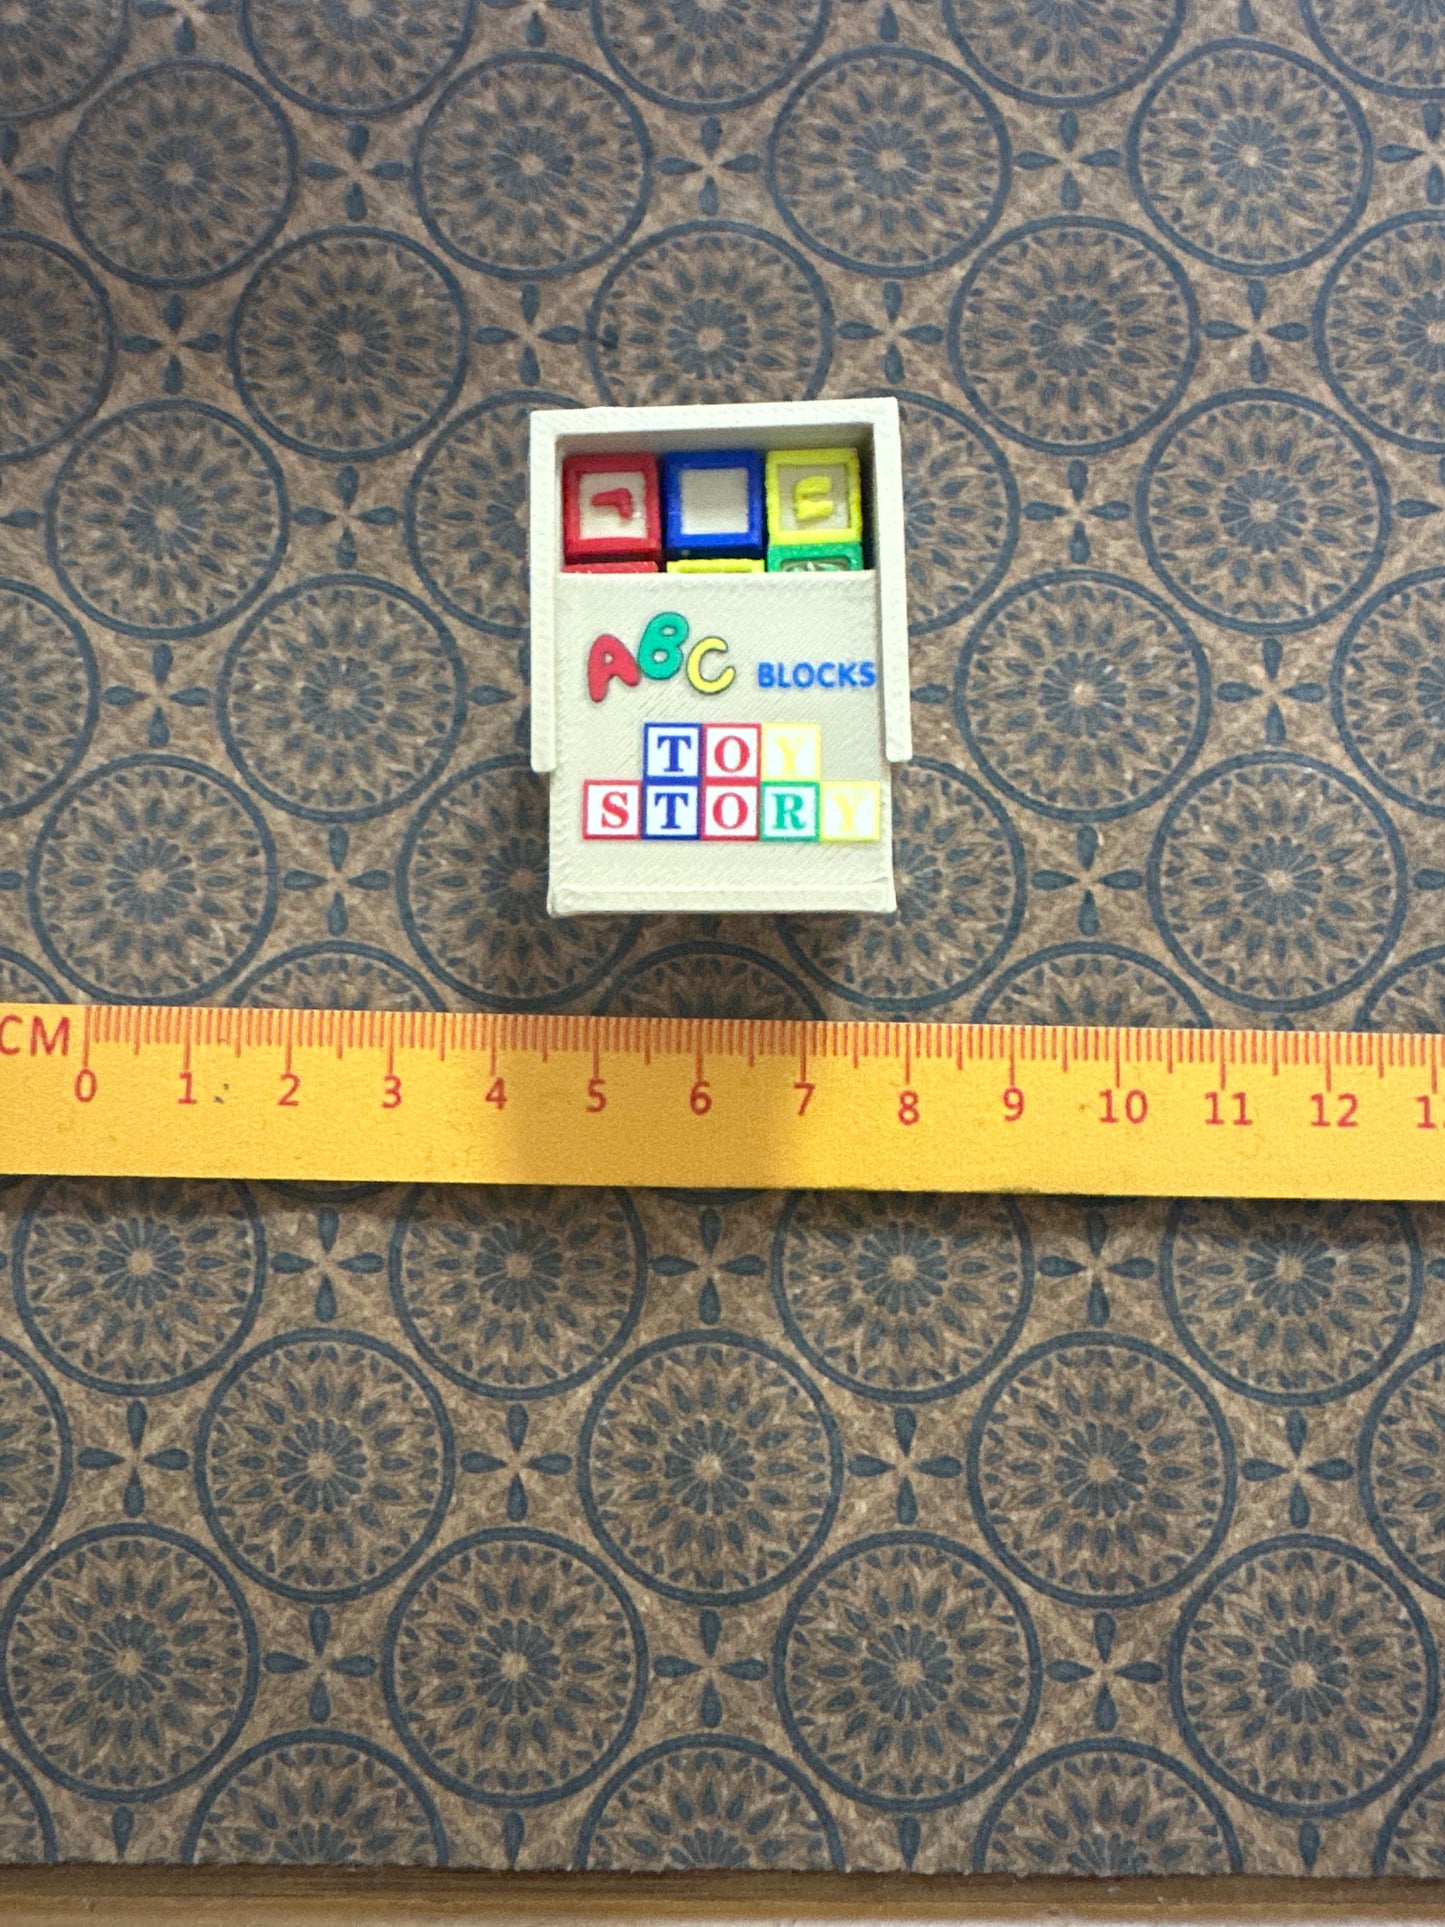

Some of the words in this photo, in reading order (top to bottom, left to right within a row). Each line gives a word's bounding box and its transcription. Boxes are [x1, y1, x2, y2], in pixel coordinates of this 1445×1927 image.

[587, 611, 736, 703] ABC
[756, 661, 878, 689] BLOCKS
[655, 733, 808, 774] TOY
[600, 790, 865, 832] STORY
[0, 1014, 71, 1057] CM
[74, 1068, 98, 1103] 0
[177, 1072, 197, 1105] 1
[277, 1073, 300, 1106] 2
[381, 1074, 402, 1108] 3
[485, 1077, 508, 1109] 4
[586, 1079, 607, 1113] 5
[690, 1080, 713, 1116] 6
[794, 1081, 816, 1116] 7
[898, 1090, 921, 1126] 8
[1002, 1087, 1026, 1122] 9
[1099, 1089, 1149, 1124] 10
[1204, 1091, 1254, 1126] 11
[1310, 1092, 1360, 1129] 12
[1415, 1095, 1445, 1129] 1
